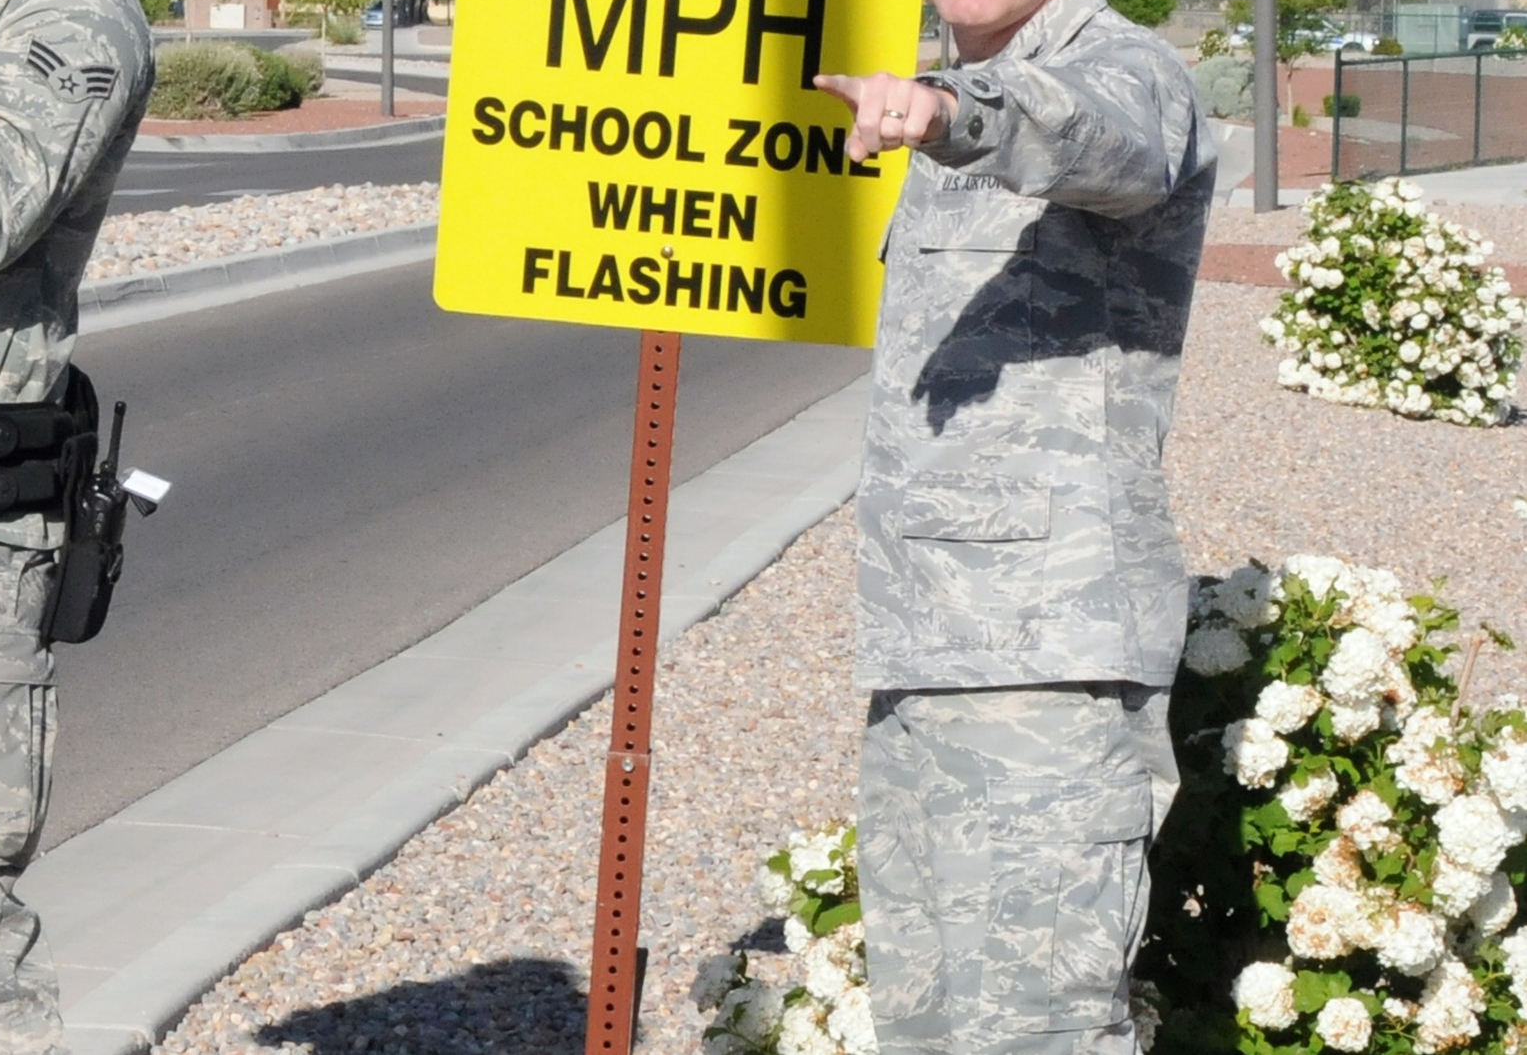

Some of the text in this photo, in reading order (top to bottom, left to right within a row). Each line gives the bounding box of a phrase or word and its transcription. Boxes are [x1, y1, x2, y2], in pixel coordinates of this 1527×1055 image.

[472, 97, 704, 162] SCHOOL
[588, 182, 757, 241] WHEN
[522, 248, 807, 318] FLASHING
